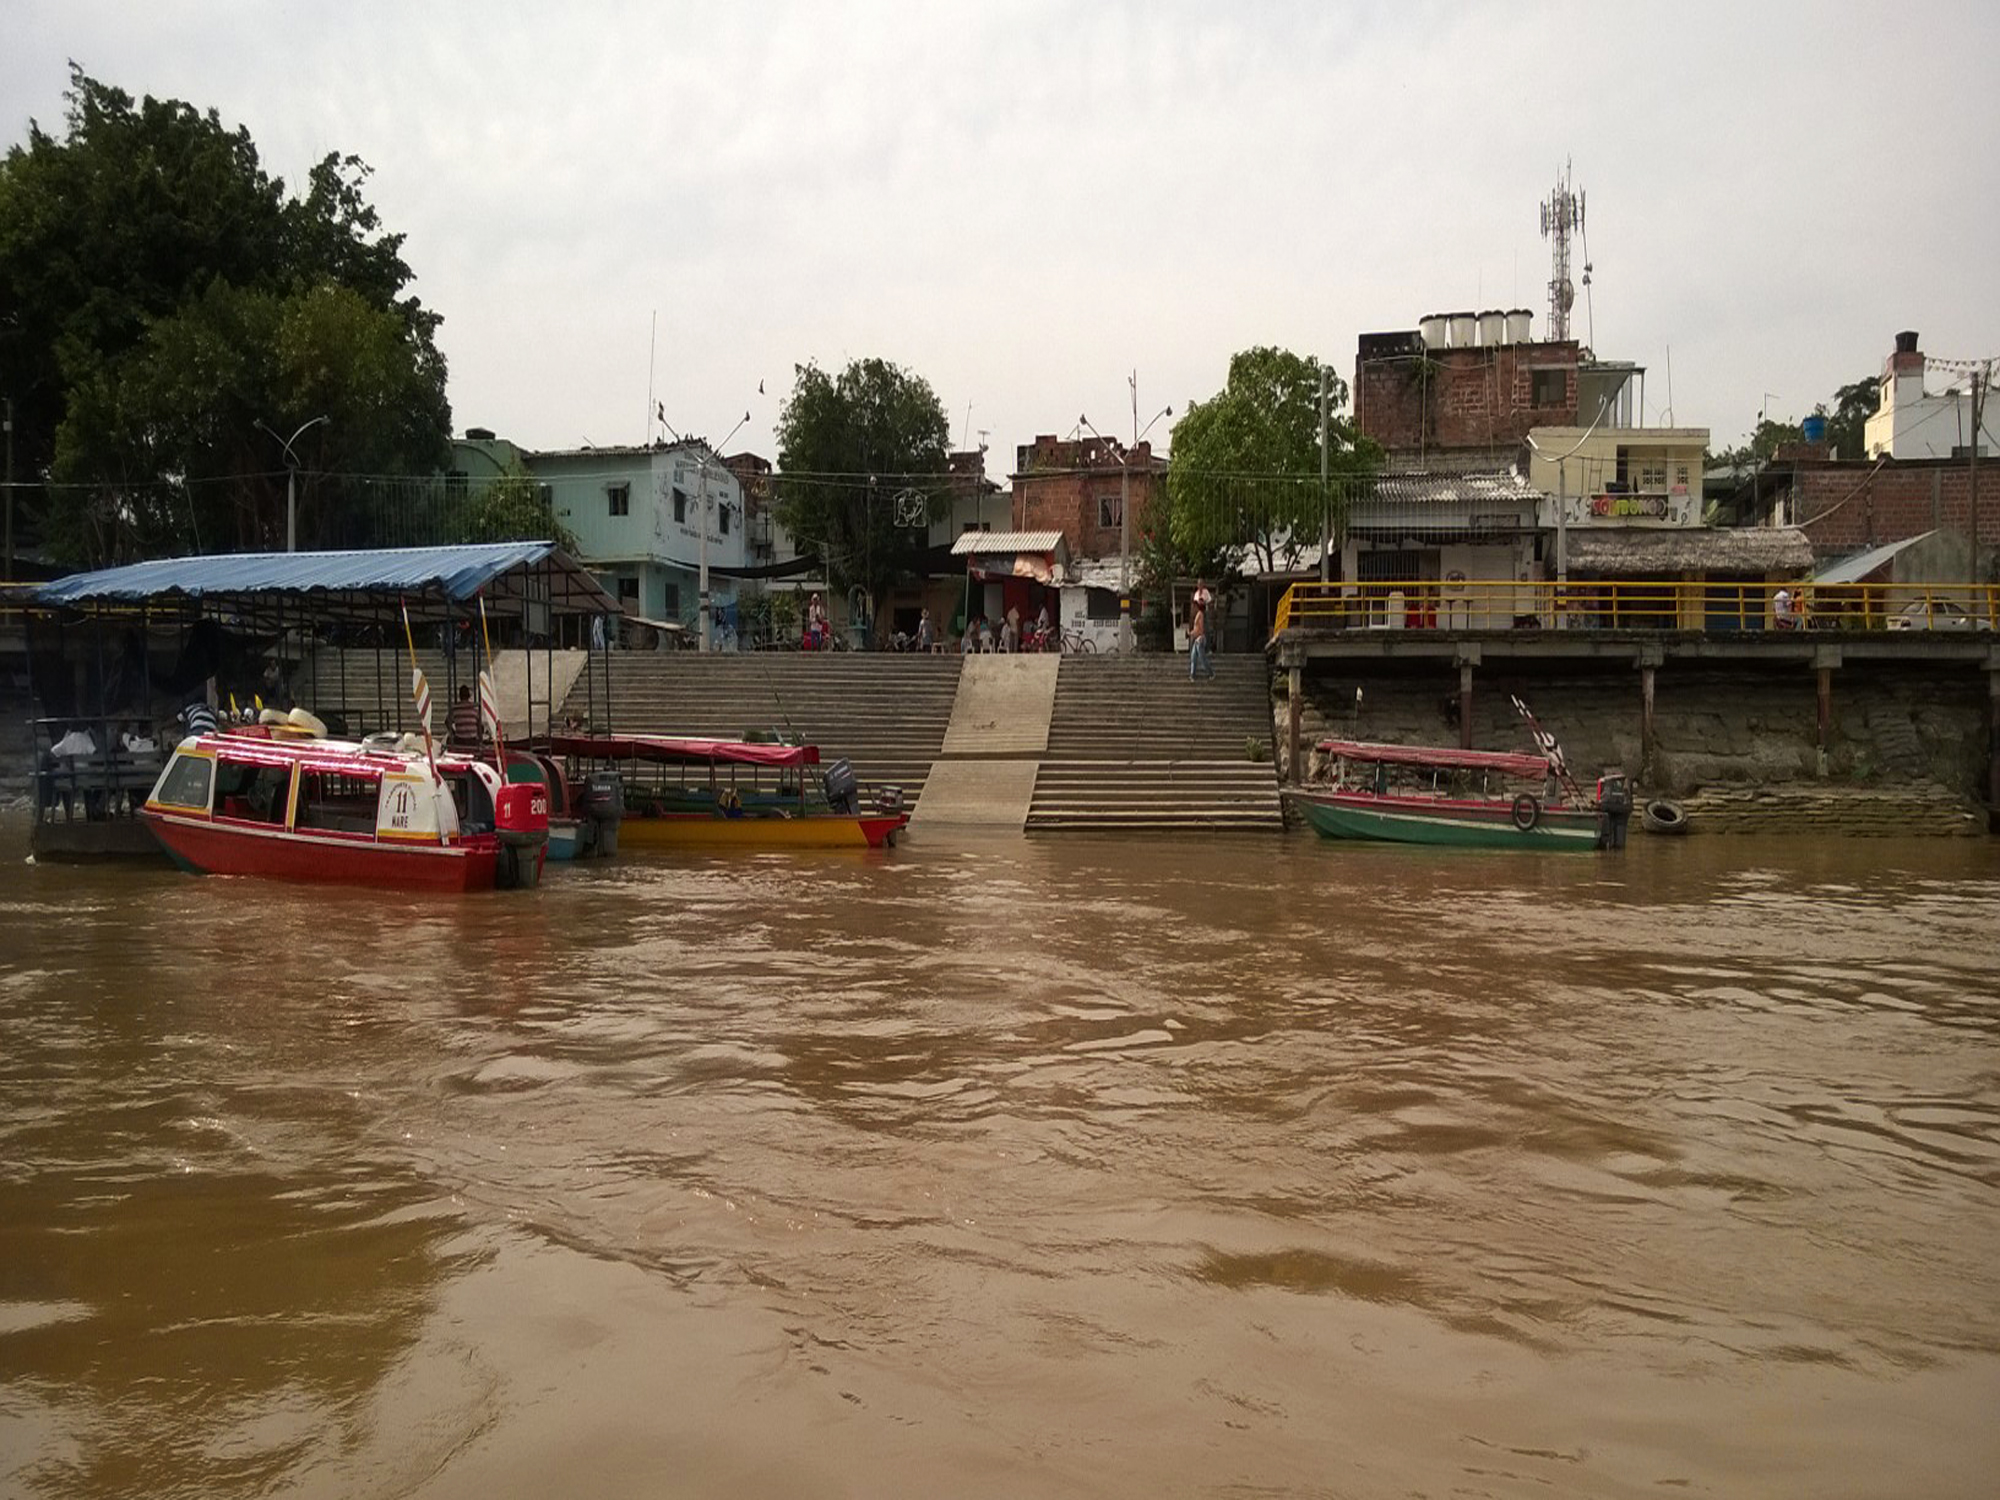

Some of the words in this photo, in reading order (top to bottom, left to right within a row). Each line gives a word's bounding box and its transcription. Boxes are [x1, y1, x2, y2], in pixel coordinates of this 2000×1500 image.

[397, 791, 408, 813] 11
[504, 803, 511, 818] 11
[531, 798, 547, 815] 200
